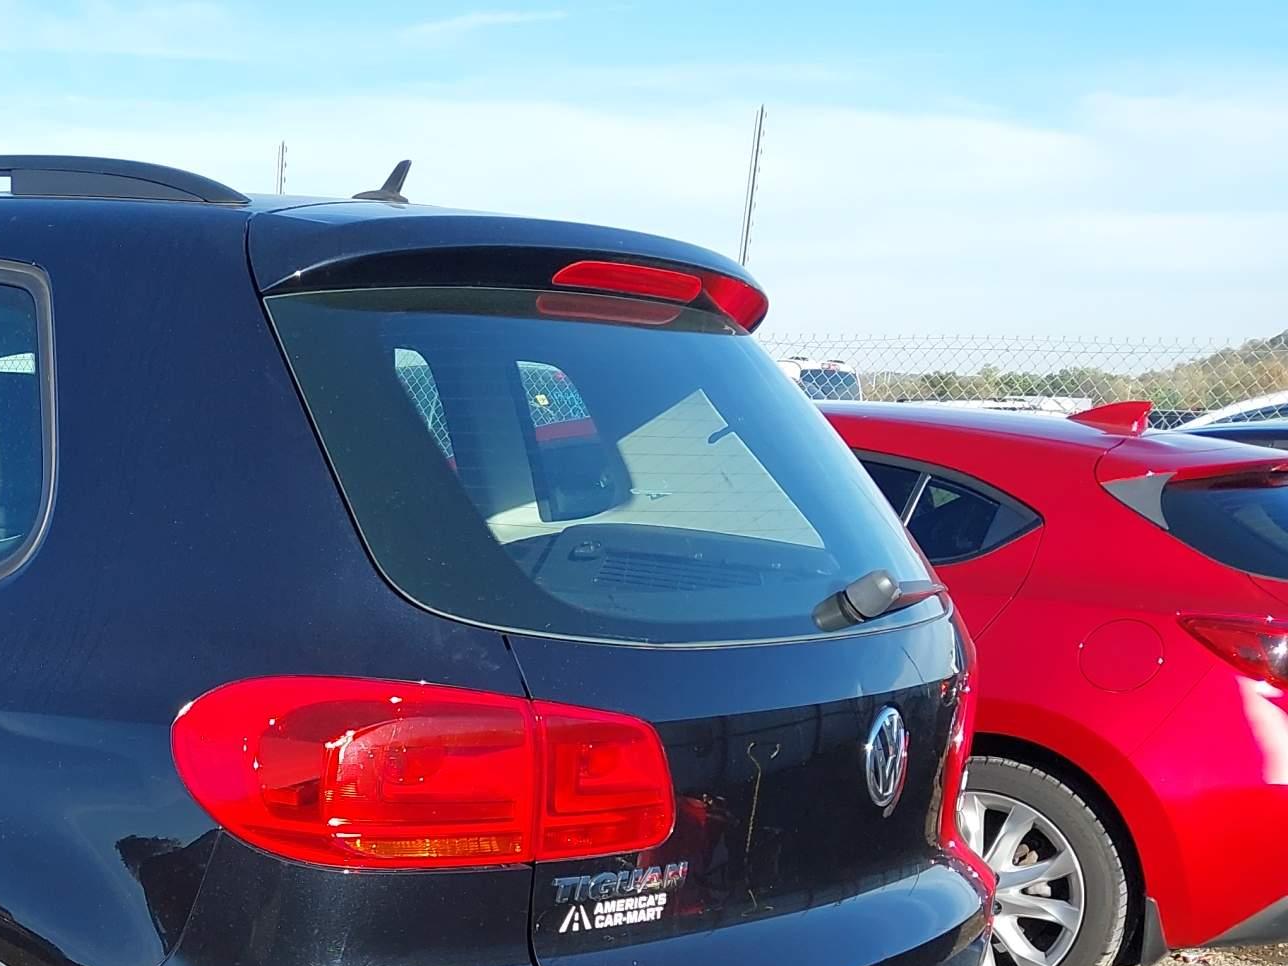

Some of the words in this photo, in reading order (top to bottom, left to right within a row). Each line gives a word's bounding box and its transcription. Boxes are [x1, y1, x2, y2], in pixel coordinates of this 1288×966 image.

[553, 861, 689, 903] TIGUAN
[593, 893, 667, 915] AMERICA'S
[594, 907, 664, 929] CAR-MART
